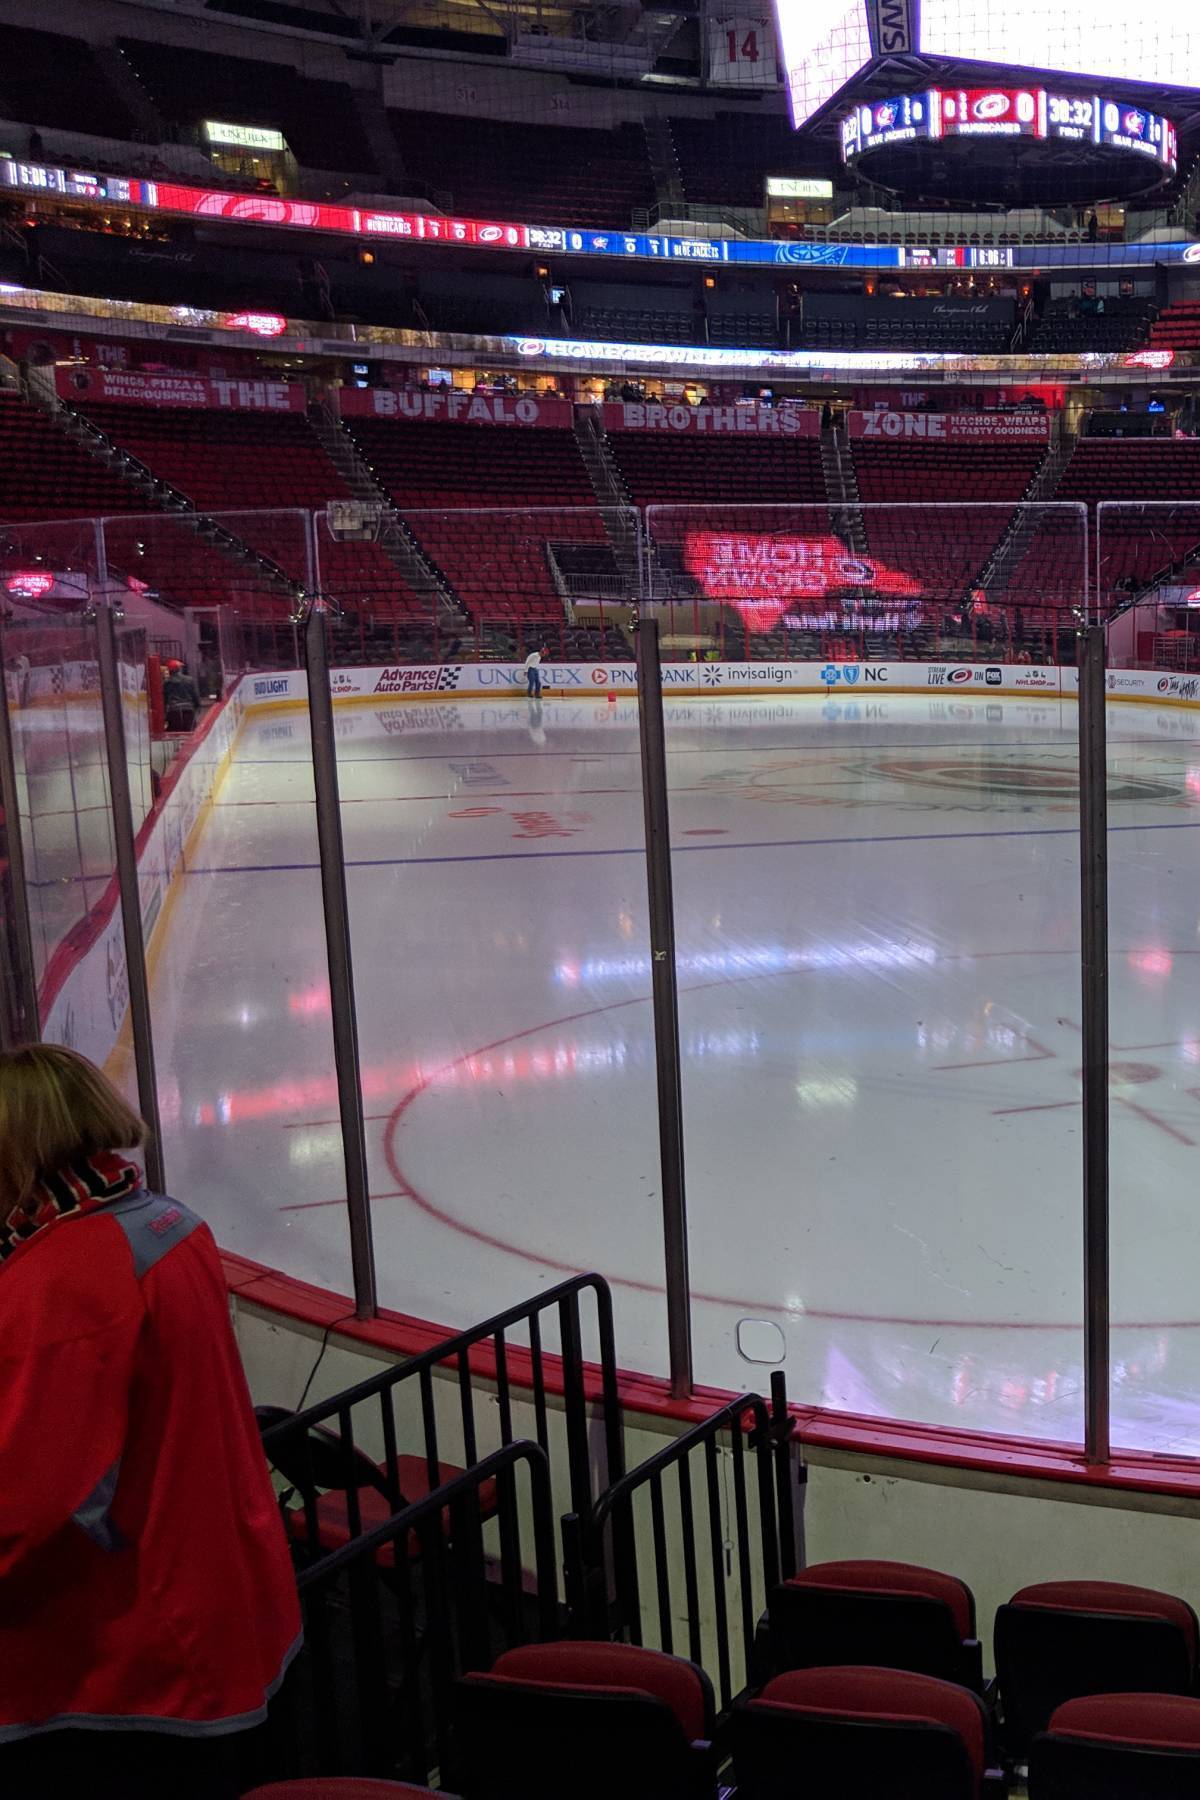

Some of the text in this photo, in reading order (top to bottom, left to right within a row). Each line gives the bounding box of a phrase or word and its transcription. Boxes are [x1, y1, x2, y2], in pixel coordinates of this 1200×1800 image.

[725, 30, 759, 63] 14
[367, 219, 411, 234] HURRICANES
[212, 380, 290, 408] THE
[374, 390, 539, 422] BUFFALO
[623, 404, 800, 432] BROTHERS
[863, 412, 946, 437] ZONE
[951, 416, 1047, 426] NACHOS, WRAPS
[960, 427, 993, 435] TASTY
[994, 427, 1047, 435] GOODNESS
[380, 669, 437, 681] Advance
[728, 667, 792, 683] invisalign
[864, 668, 888, 681] NC
[928, 672, 984, 685] LIVE ON
[267, 680, 288, 693] LIGHT
[373, 680, 434, 693] Auto Parts
[1116, 678, 1145, 687] SECURITY
